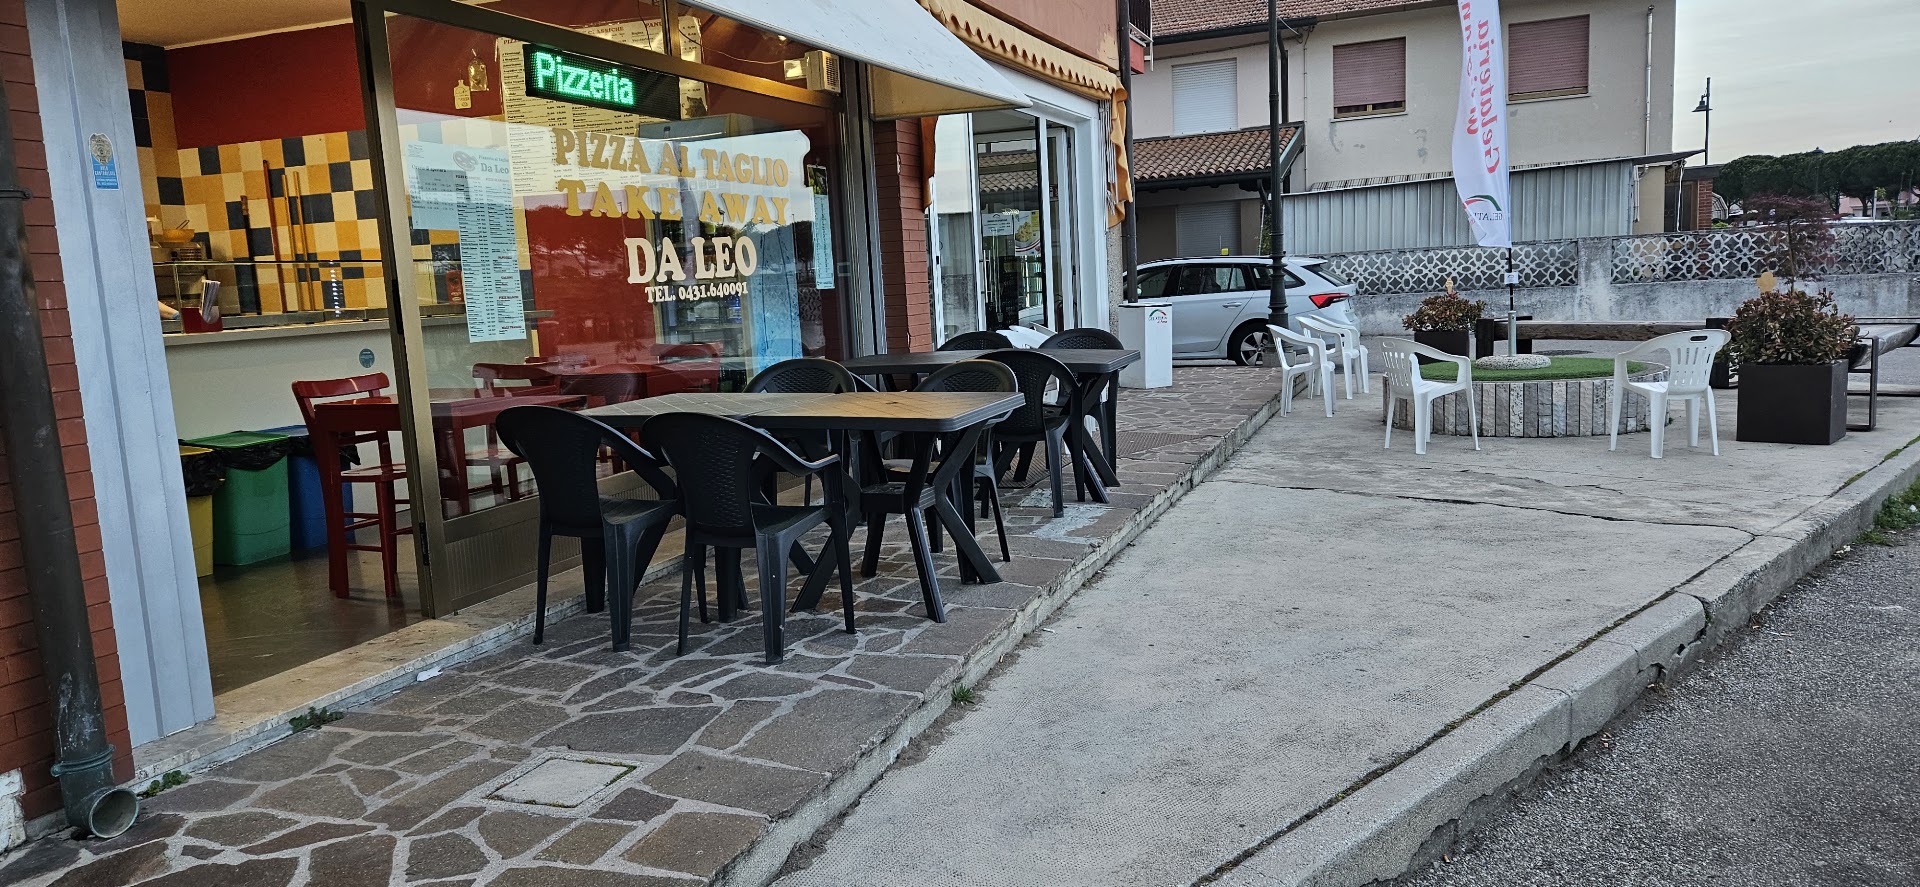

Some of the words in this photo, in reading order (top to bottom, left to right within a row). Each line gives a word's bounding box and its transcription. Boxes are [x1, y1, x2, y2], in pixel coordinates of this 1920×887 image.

[535, 51, 635, 106] Pizzeria
[480, 162, 493, 172] Da
[495, 164, 509, 174] Leo
[552, 127, 651, 174] PIZZA
[658, 142, 696, 178] AL
[701, 148, 789, 188] TAGLIO
[558, 178, 682, 221] TAKE
[699, 190, 789, 225] AWAY
[624, 236, 686, 284] DA
[691, 235, 758, 280] LEO
[645, 285, 676, 303] TEL.
[678, 281, 749, 301] 0431.640091
